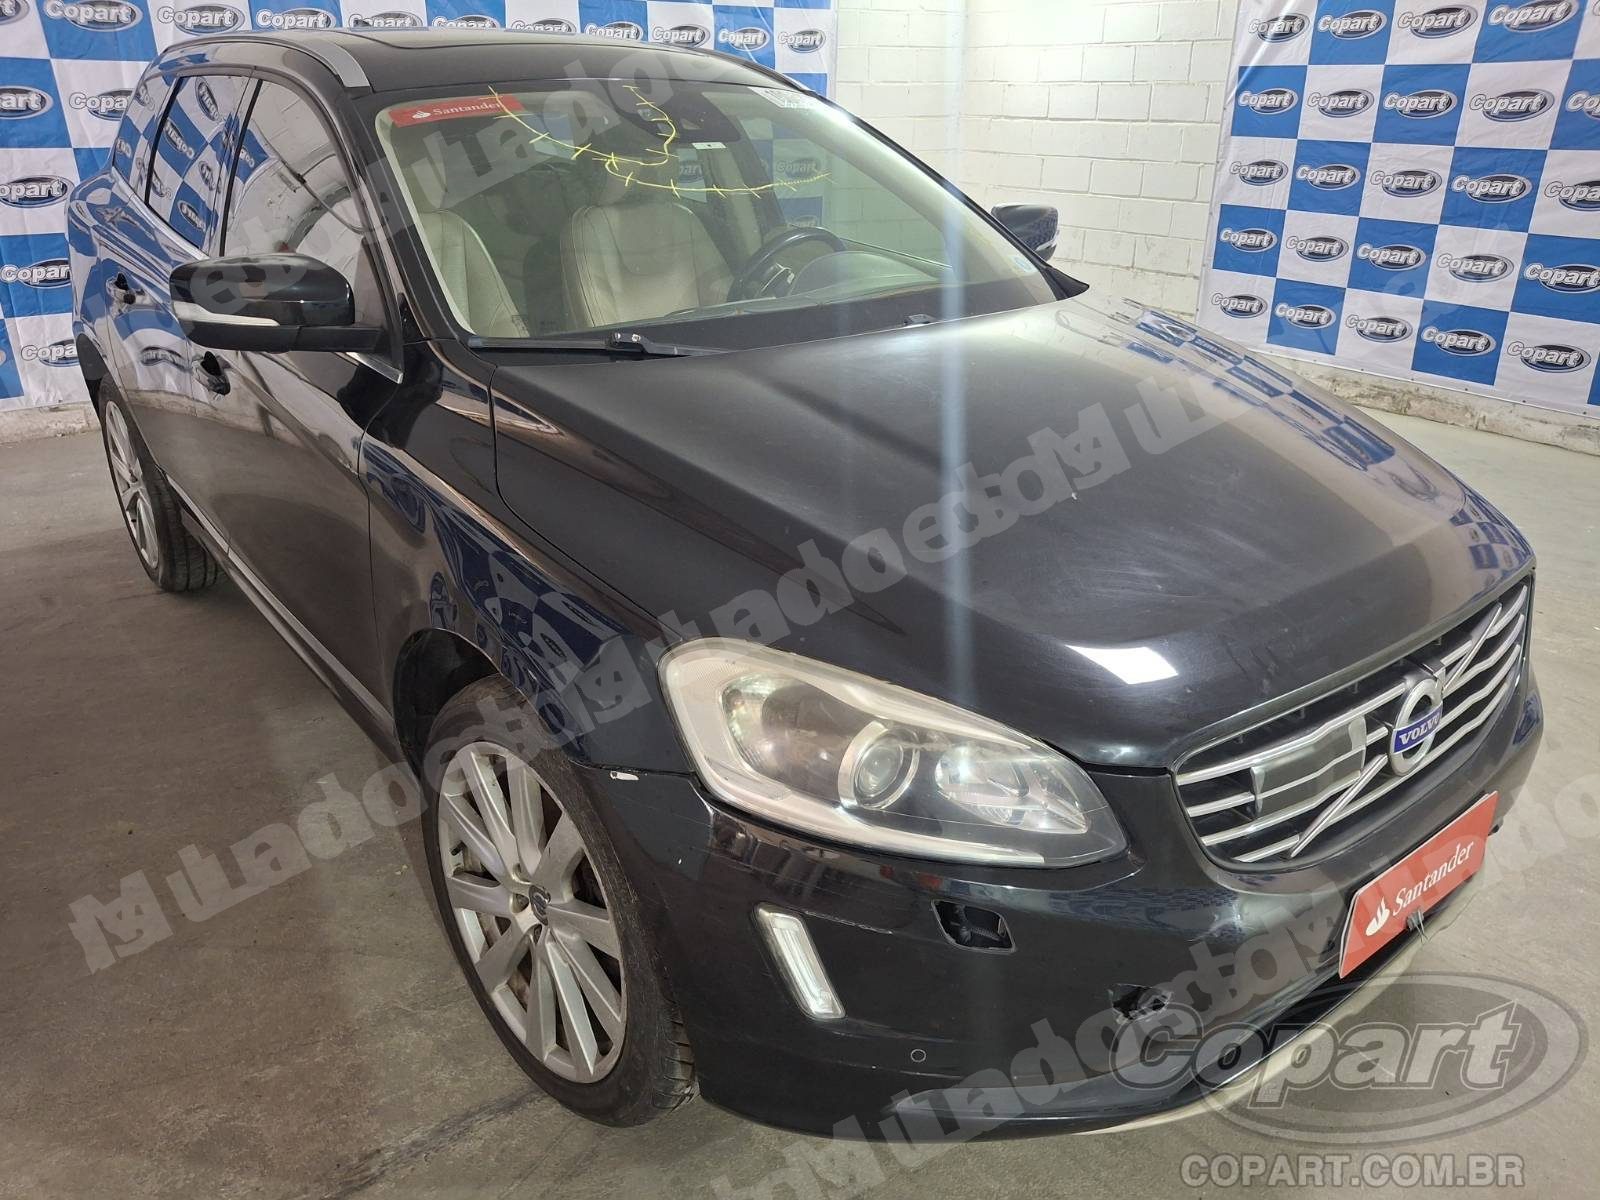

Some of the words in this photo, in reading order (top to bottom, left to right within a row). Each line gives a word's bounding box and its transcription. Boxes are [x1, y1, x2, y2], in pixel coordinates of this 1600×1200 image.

[45, 0, 133, 23] Copart
[157, 6, 235, 29] Copart
[256, 9, 327, 29] Copart
[1398, 9, 1468, 32] Copart
[1489, 1, 1571, 28] Copart
[585, 23, 637, 40] Copart
[653, 27, 702, 42] Copart
[1250, 14, 1301, 35] Copart
[1318, 13, 1377, 35] Copart
[718, 30, 764, 48] Copart
[778, 31, 821, 47] Copart
[69, 92, 127, 113] Copa
[432, 102, 501, 116] Santander
[1238, 90, 1291, 109] Copart
[1307, 91, 1368, 110] Copart
[1383, 91, 1451, 111] Copart
[1469, 93, 1546, 115] Copart
[1229, 161, 1282, 179] Copart
[1296, 164, 1354, 184] Copart
[1370, 170, 1436, 190] Copart
[0, 179, 62, 202] opart
[1452, 175, 1524, 197] Copart
[1544, 181, 1600, 203] Copa
[1220, 228, 1271, 247] Copart
[1286, 235, 1342, 256] Copart
[1357, 243, 1420, 265] Copart
[1437, 253, 1506, 276] Copart
[2, 264, 70, 284] Copar
[1524, 262, 1600, 287] Copart
[1211, 293, 1263, 312] Copart
[1275, 303, 1331, 324] Copart
[1346, 315, 1407, 337] Copart
[1421, 326, 1491, 351] Copart
[21, 345, 78, 361] Copa
[1507, 341, 1584, 367] Copart
[1392, 841, 1474, 917] Santander
